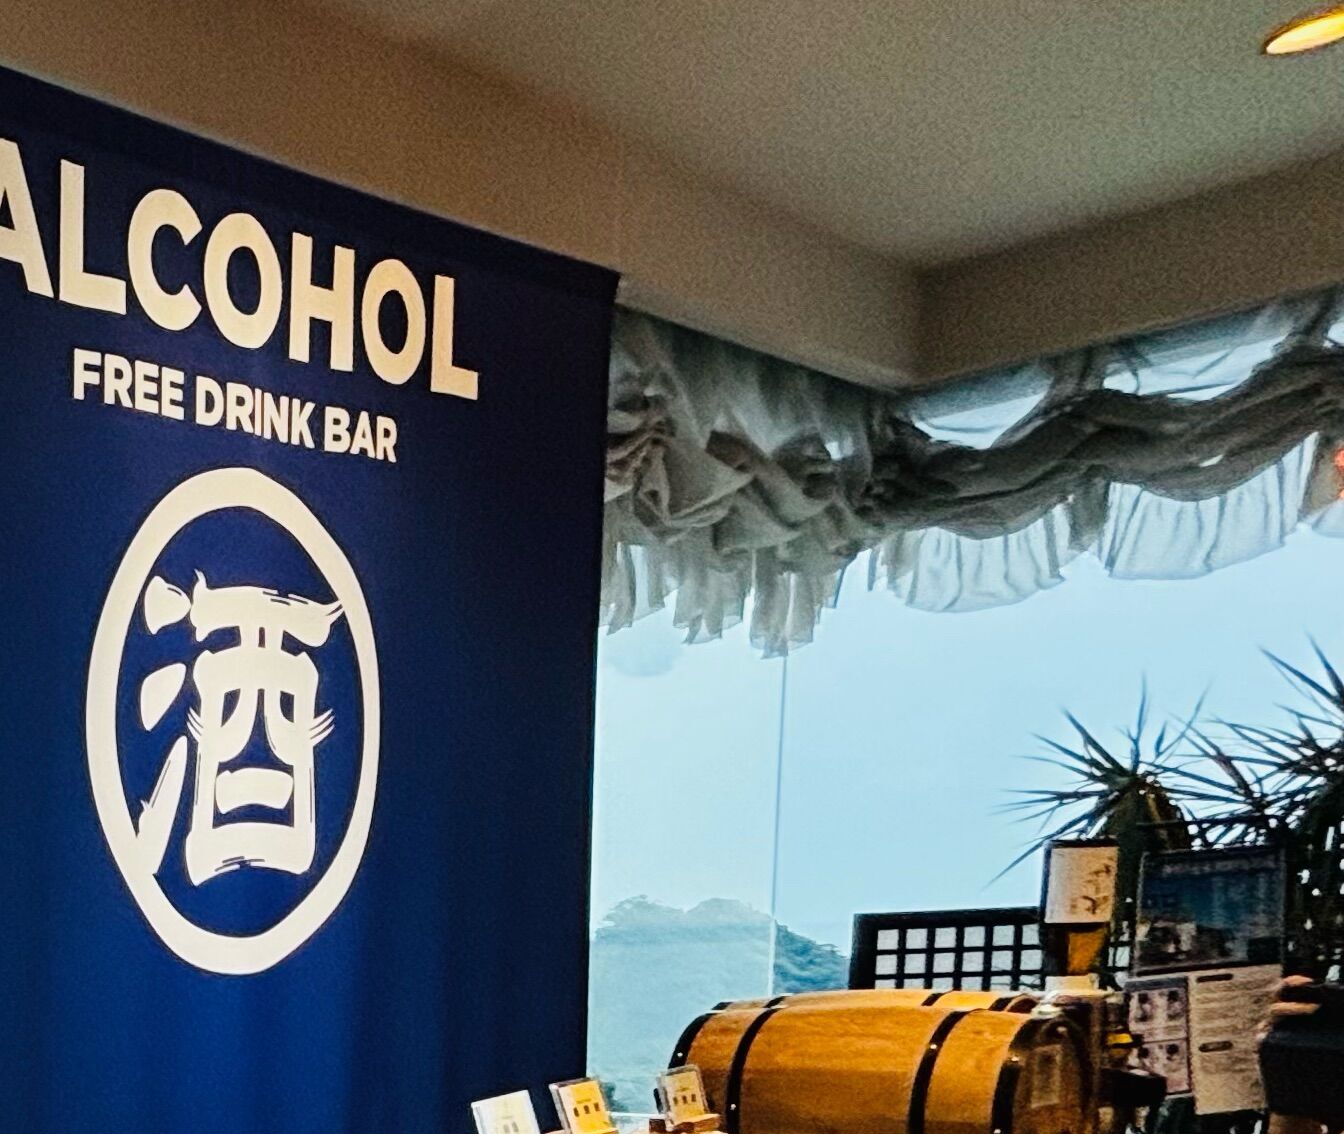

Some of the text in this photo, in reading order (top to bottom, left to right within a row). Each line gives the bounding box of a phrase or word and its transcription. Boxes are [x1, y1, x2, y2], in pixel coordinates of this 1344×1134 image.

[73, 349, 398, 463] FREE DRINK BAR
[138, 571, 346, 885] 酒
